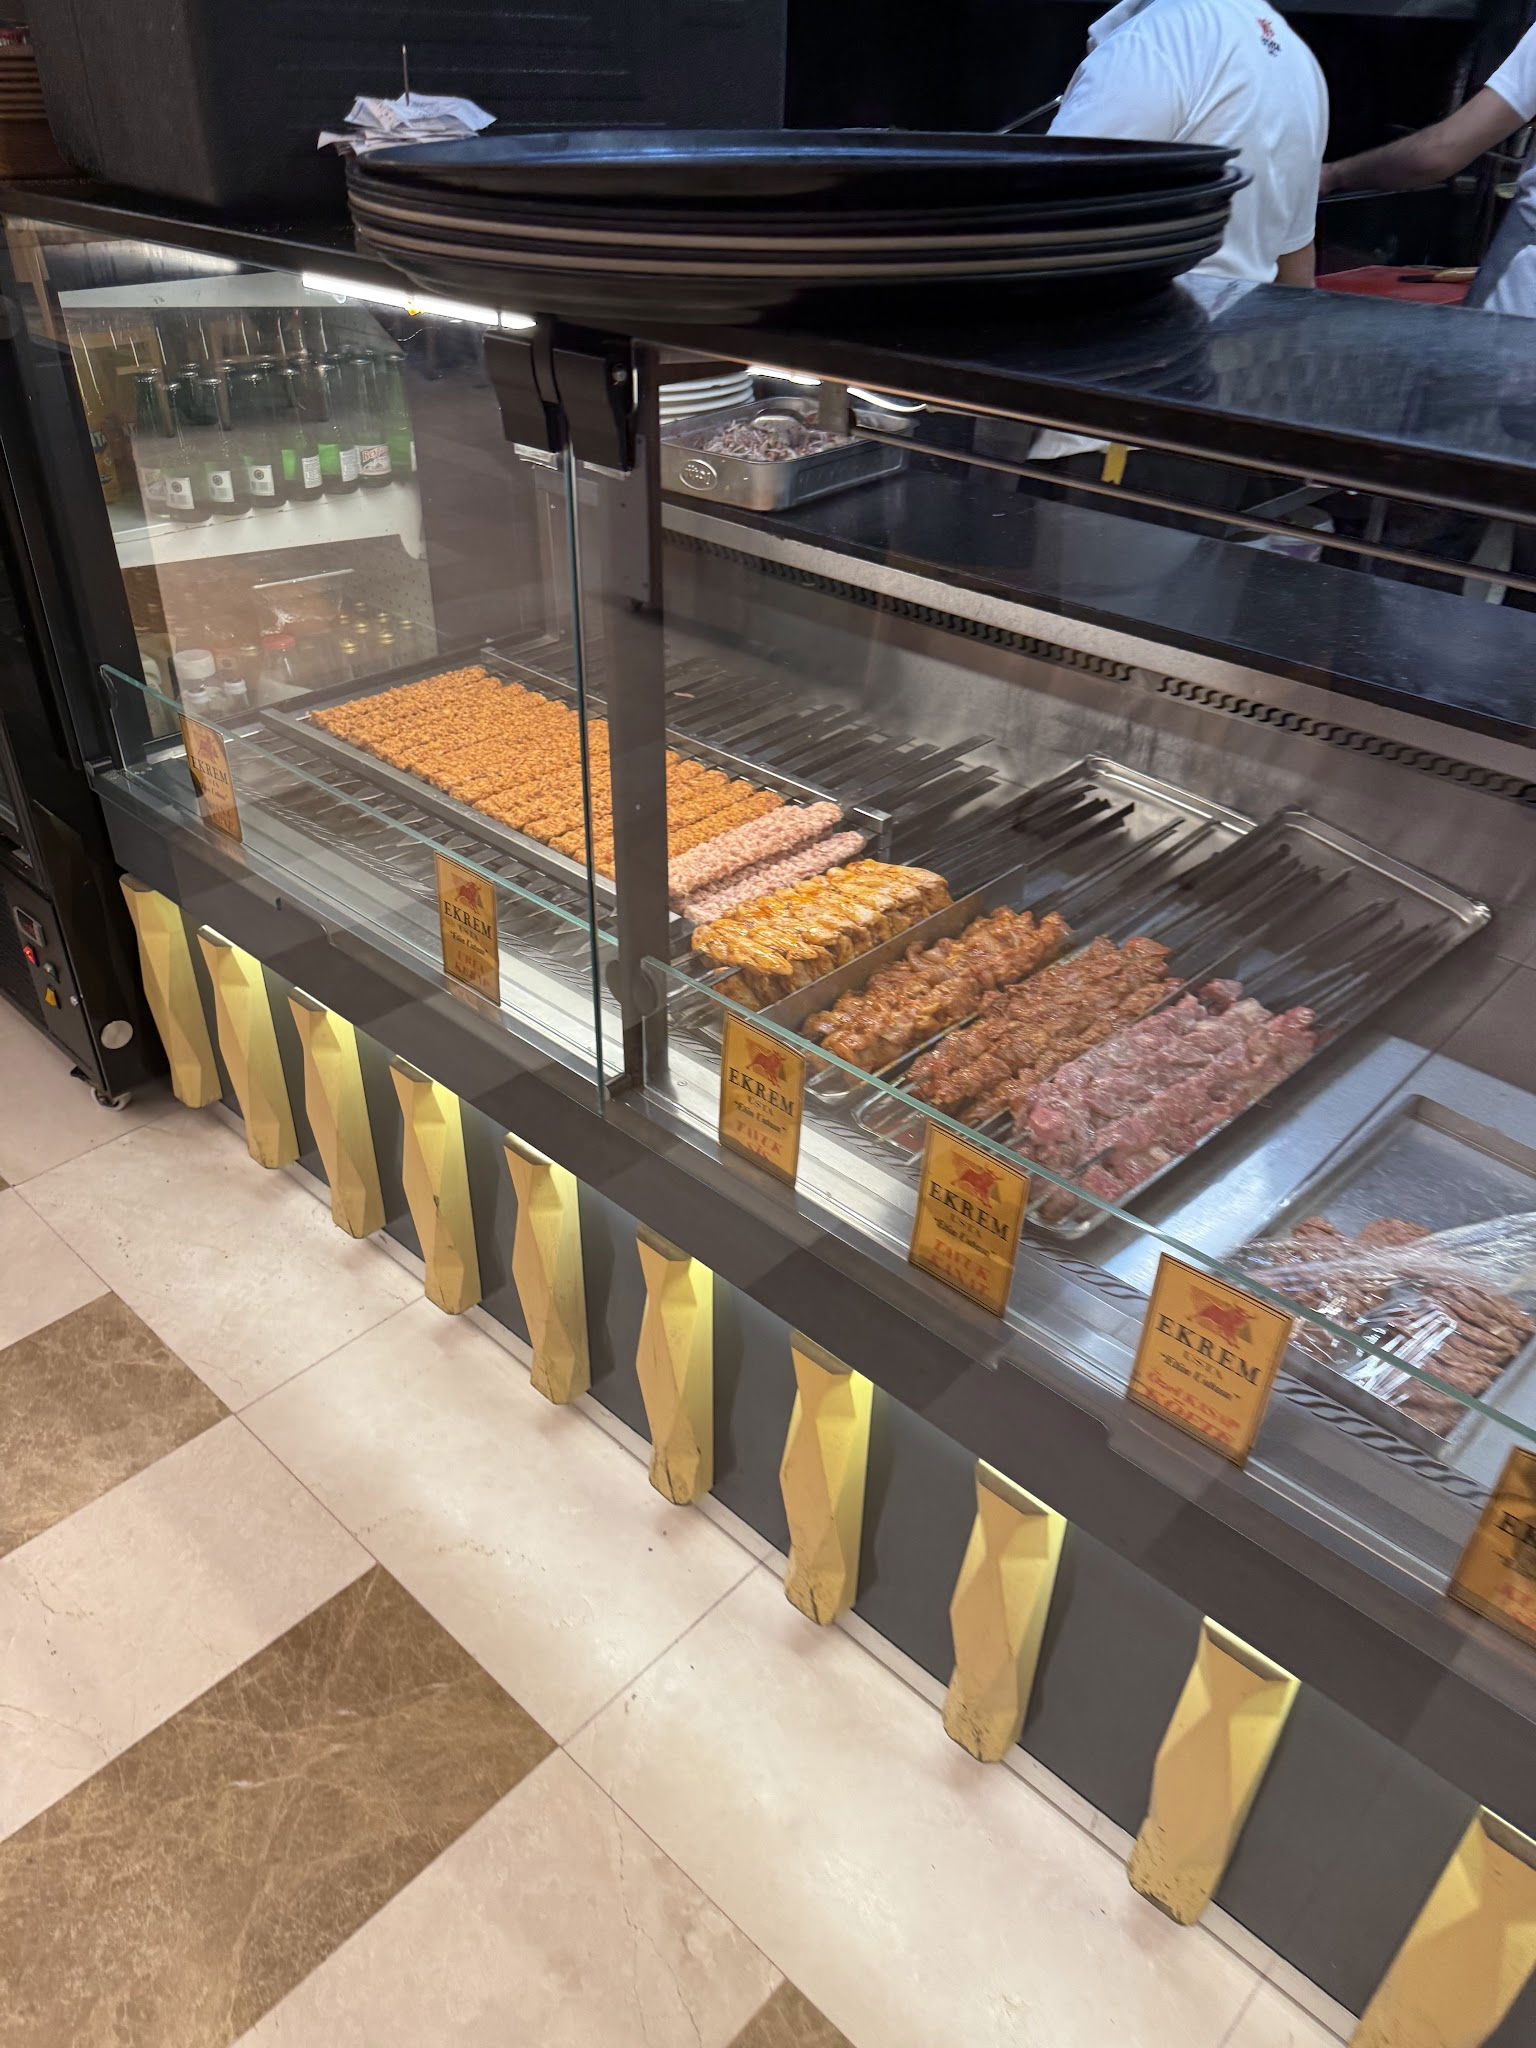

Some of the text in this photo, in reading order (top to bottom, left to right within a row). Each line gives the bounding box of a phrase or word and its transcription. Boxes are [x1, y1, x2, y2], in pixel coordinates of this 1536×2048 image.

[443, 899, 492, 940] EKREM
[728, 1065, 793, 1116] EKREM
[747, 1095, 773, 1116] USTA
[928, 1180, 1010, 1241] EKREM
[1155, 1313, 1262, 1385] EKREM
[1181, 1349, 1224, 1380] USTA
